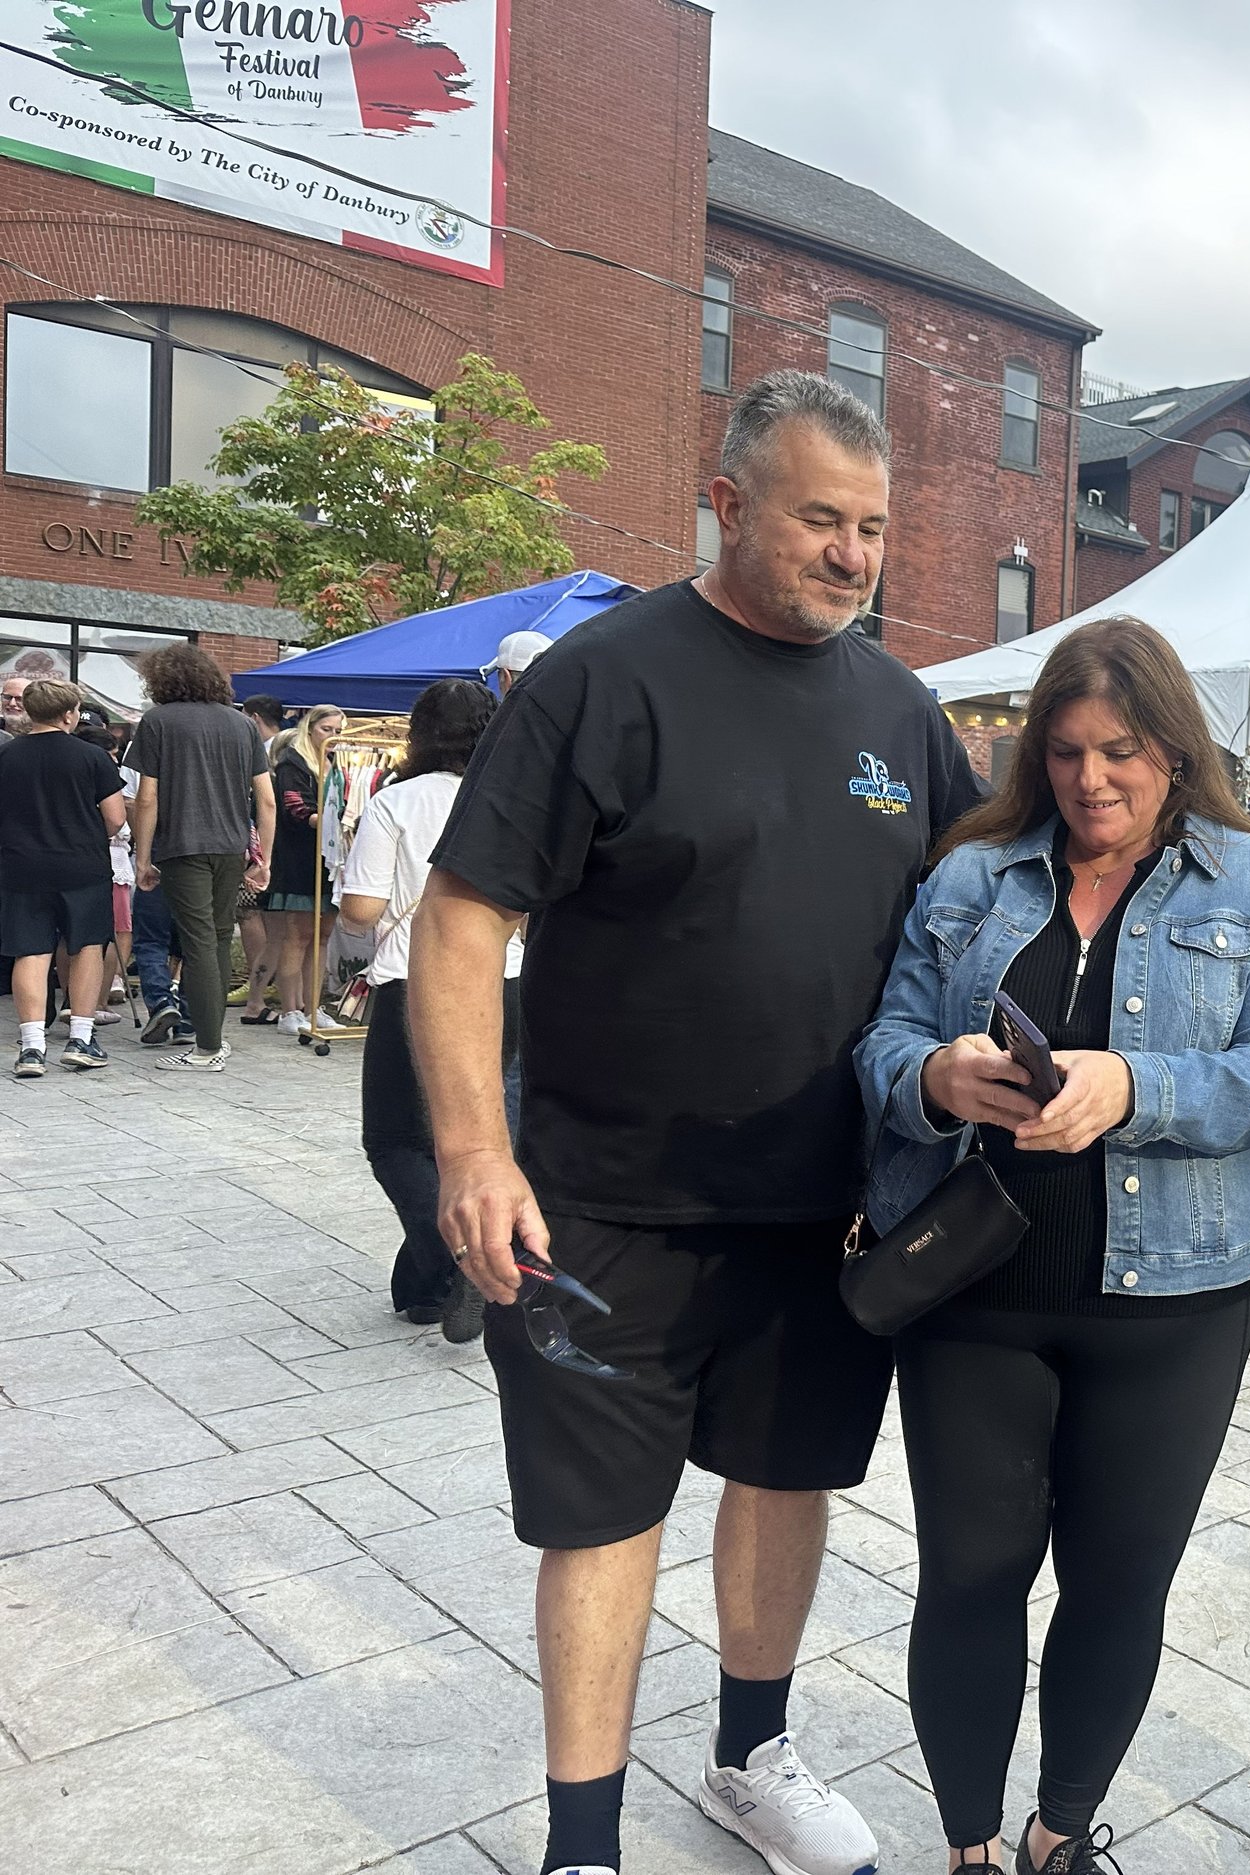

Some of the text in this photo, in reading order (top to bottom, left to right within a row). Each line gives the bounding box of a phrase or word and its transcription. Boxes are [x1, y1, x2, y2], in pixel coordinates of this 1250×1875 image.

[142, 0, 364, 48] Gennaro
[214, 40, 321, 79] Festival
[227, 80, 323, 108] of Danbury
[8, 95, 163, 151] Co-sponsored
[168, 140, 192, 162] by
[200, 148, 241, 174] The
[247, 163, 290, 191] City
[295, 181, 319, 199] of
[322, 185, 410, 225] Danbury
[42, 522, 133, 560] ONE
[906, 1230, 934, 1254] VERSACE
